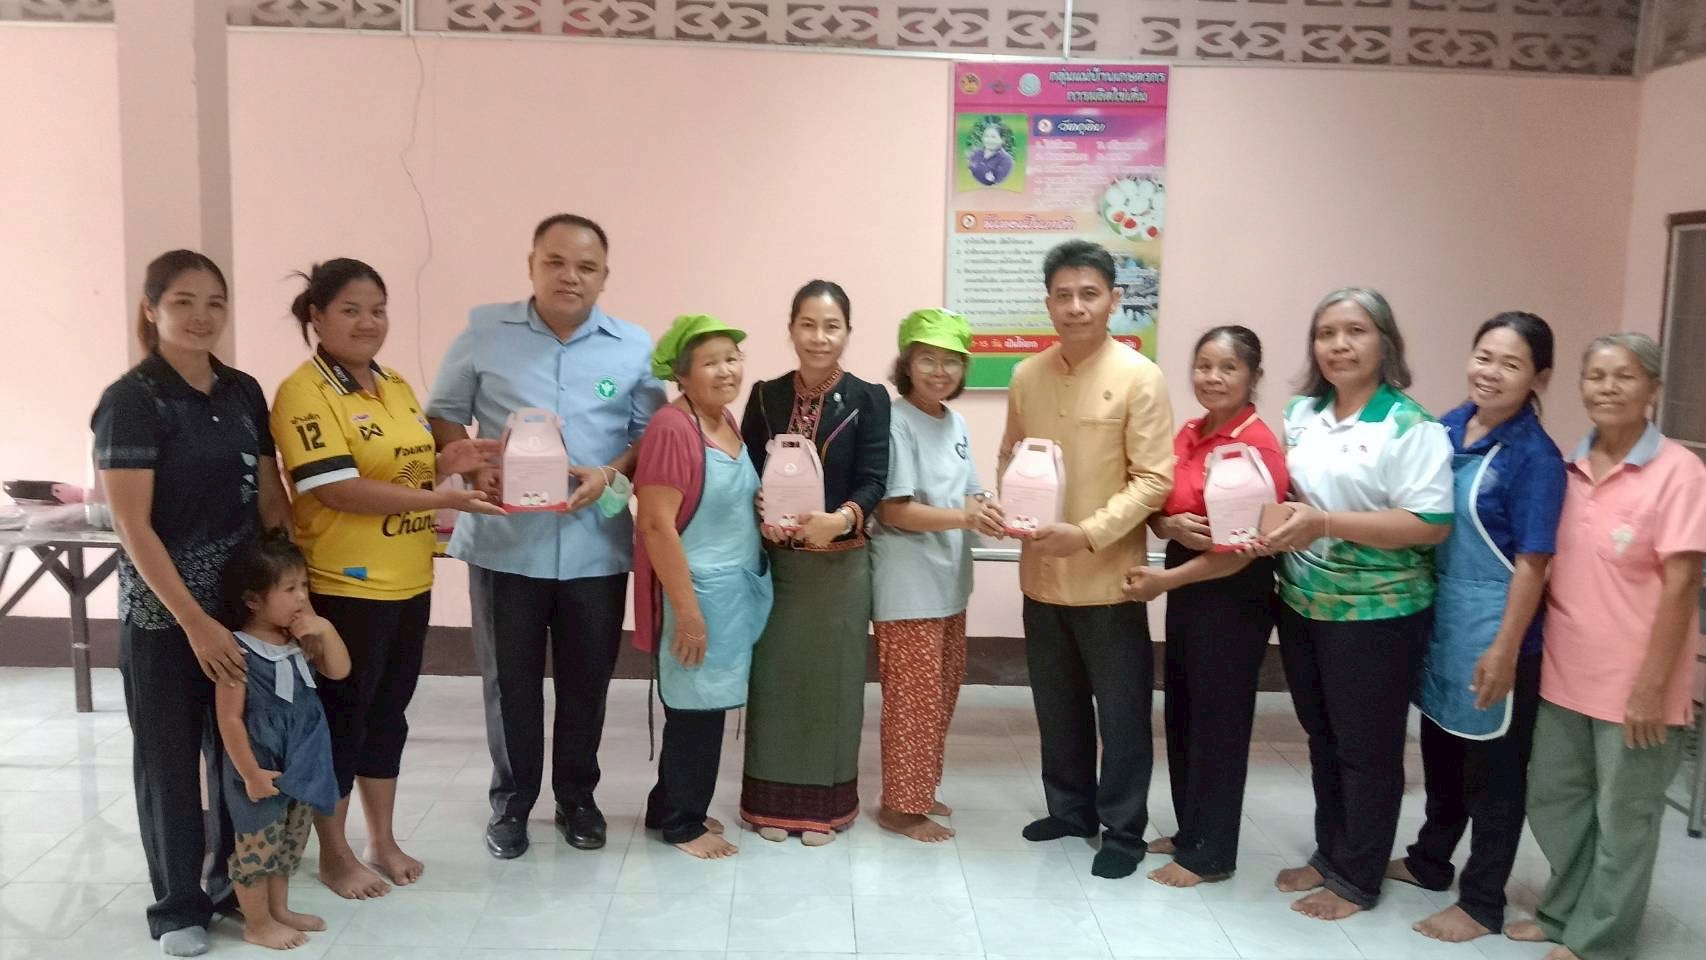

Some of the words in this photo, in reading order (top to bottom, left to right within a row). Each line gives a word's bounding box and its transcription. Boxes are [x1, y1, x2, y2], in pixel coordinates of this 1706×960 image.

[1049, 67, 1167, 87] กลุ่มแม่บ้านเกษตรกร
[1066, 86, 1148, 102] การผลิตไข่เค็ม
[1057, 118, 1105, 135] วัตถุดิบ
[296, 422, 326, 451] 12
